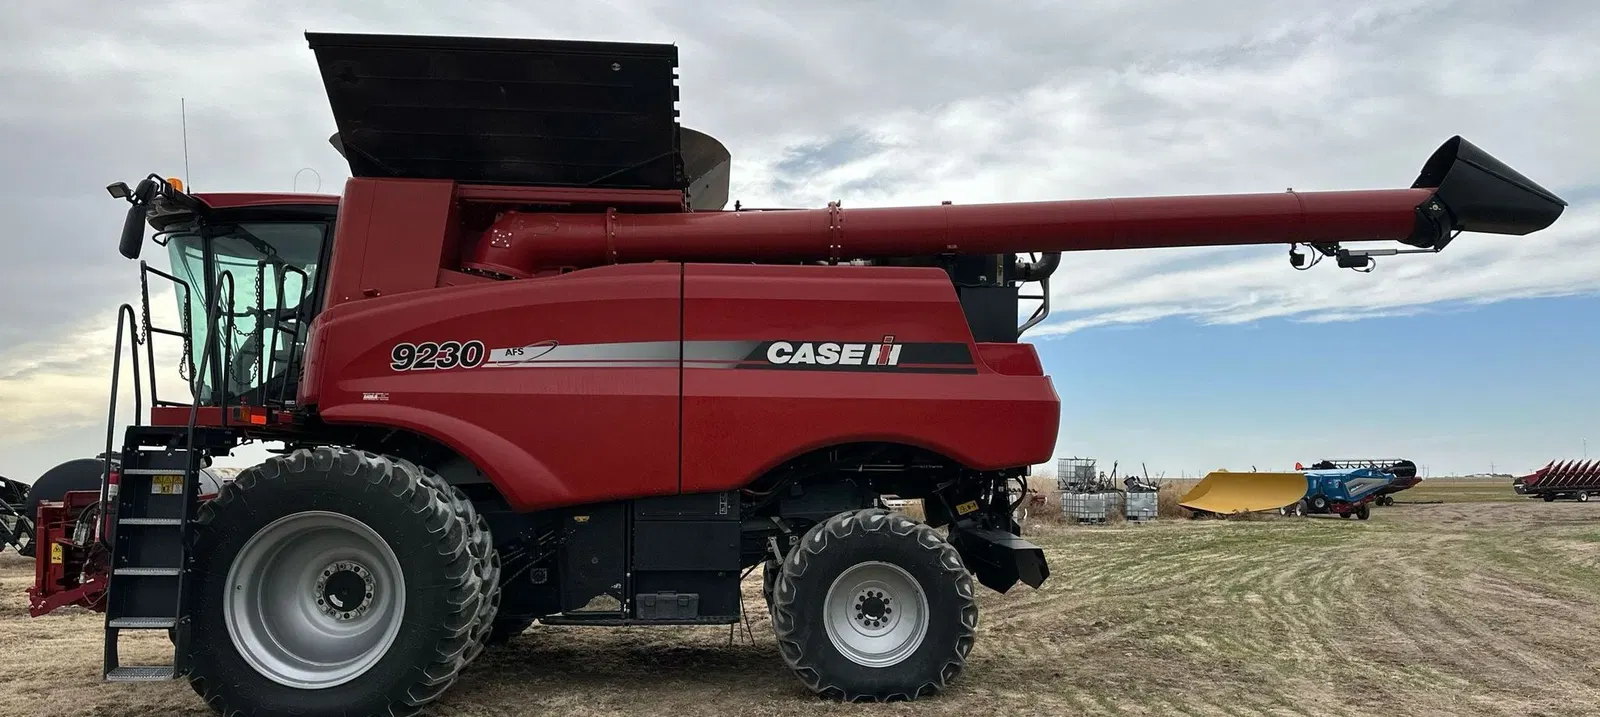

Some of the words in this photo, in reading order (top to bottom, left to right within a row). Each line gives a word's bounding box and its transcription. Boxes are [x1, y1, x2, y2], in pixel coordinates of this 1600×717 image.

[390, 340, 485, 371] 9230
[505, 347, 524, 356] AFS
[767, 341, 866, 365] CASE
